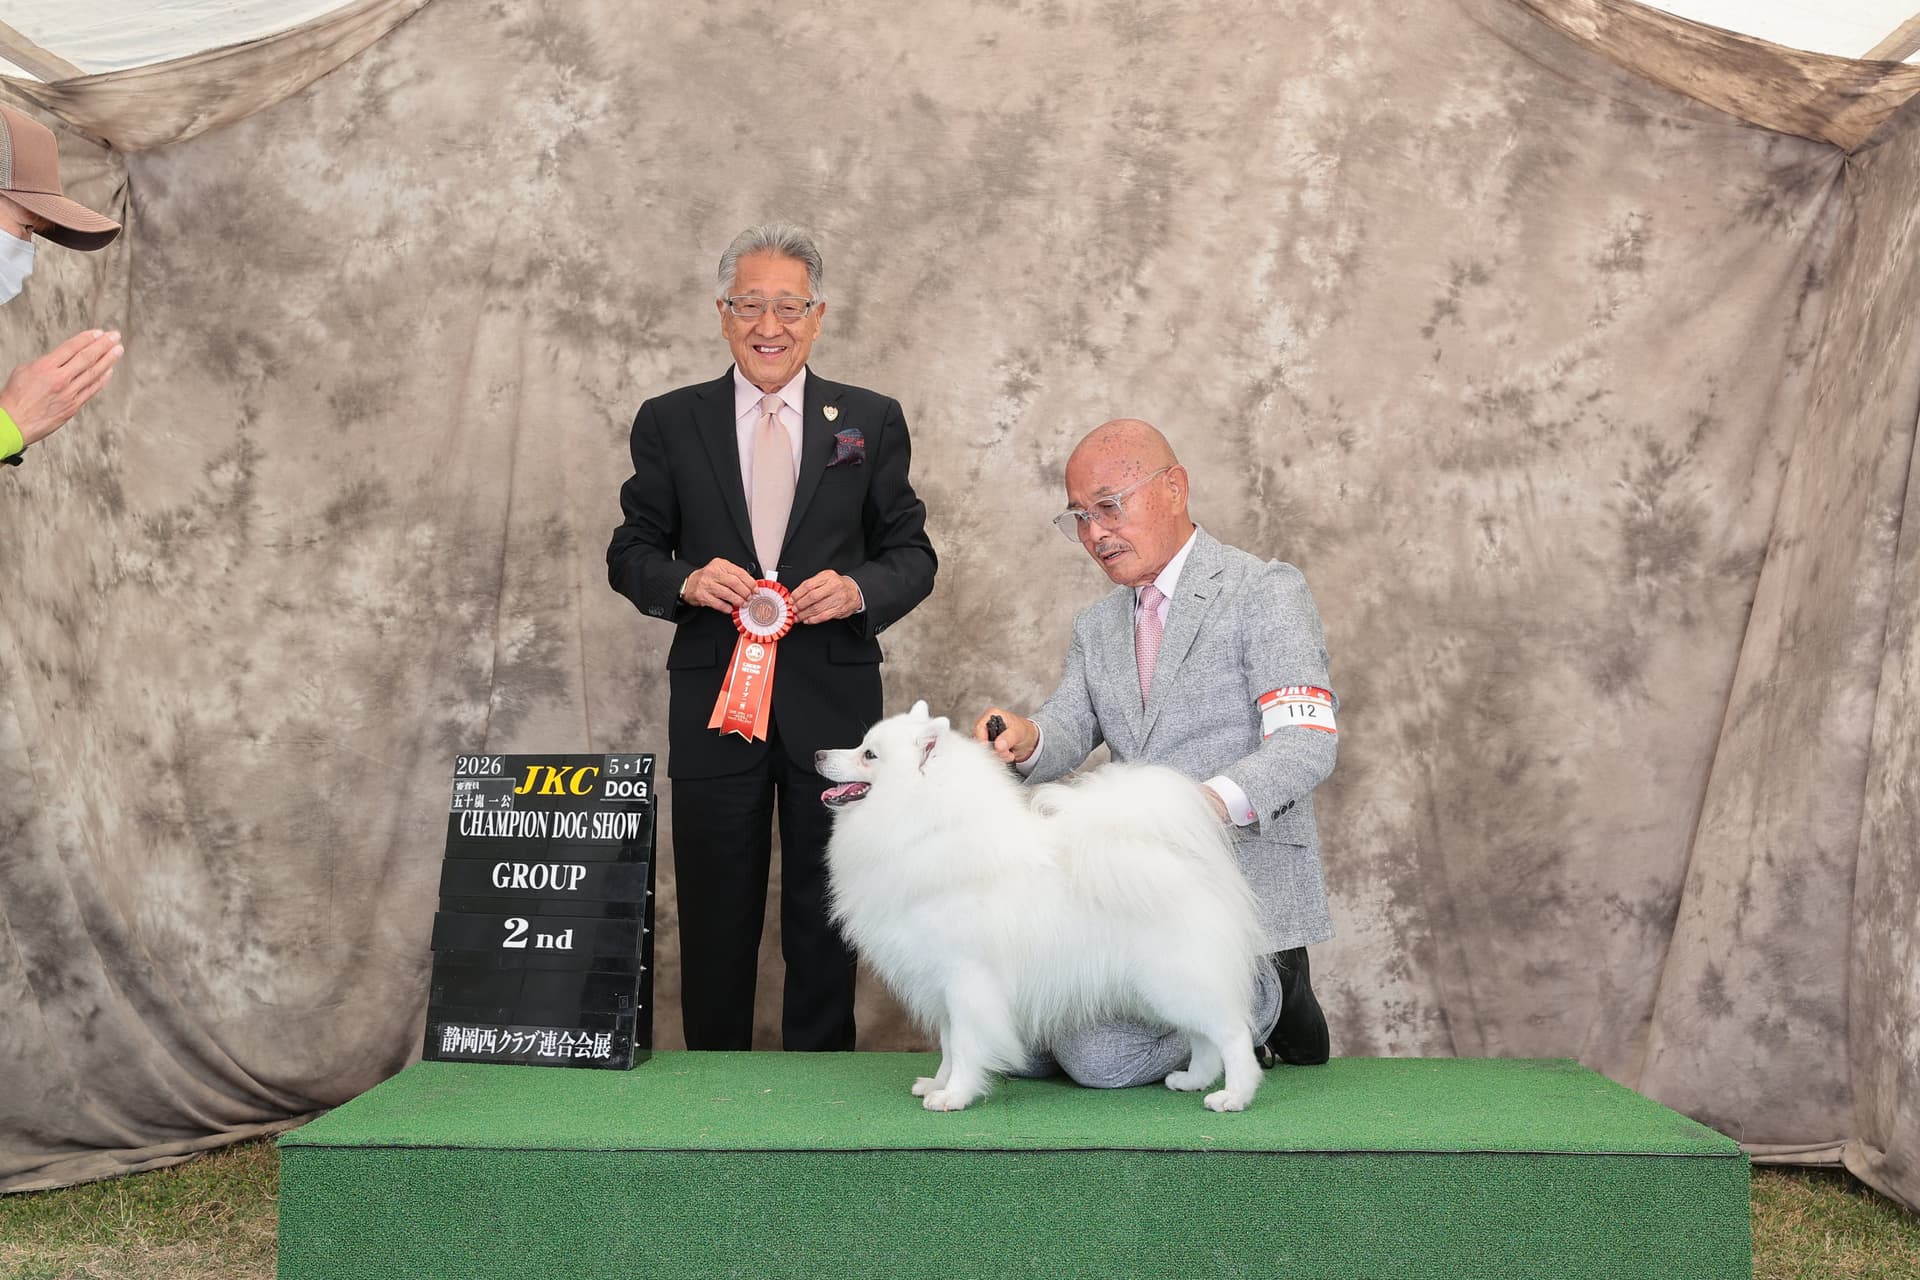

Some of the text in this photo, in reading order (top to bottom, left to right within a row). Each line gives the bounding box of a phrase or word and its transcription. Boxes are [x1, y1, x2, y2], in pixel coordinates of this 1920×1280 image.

[1287, 703, 1317, 718] 112
[456, 756, 502, 775] 2026
[514, 765, 599, 795] JKC
[605, 780, 648, 797] DOG
[460, 810, 641, 840] CHAMPION DOG SHOW
[492, 862, 586, 890] GROUP
[442, 1025, 612, 1060] 静岡西クラブ連合会展
